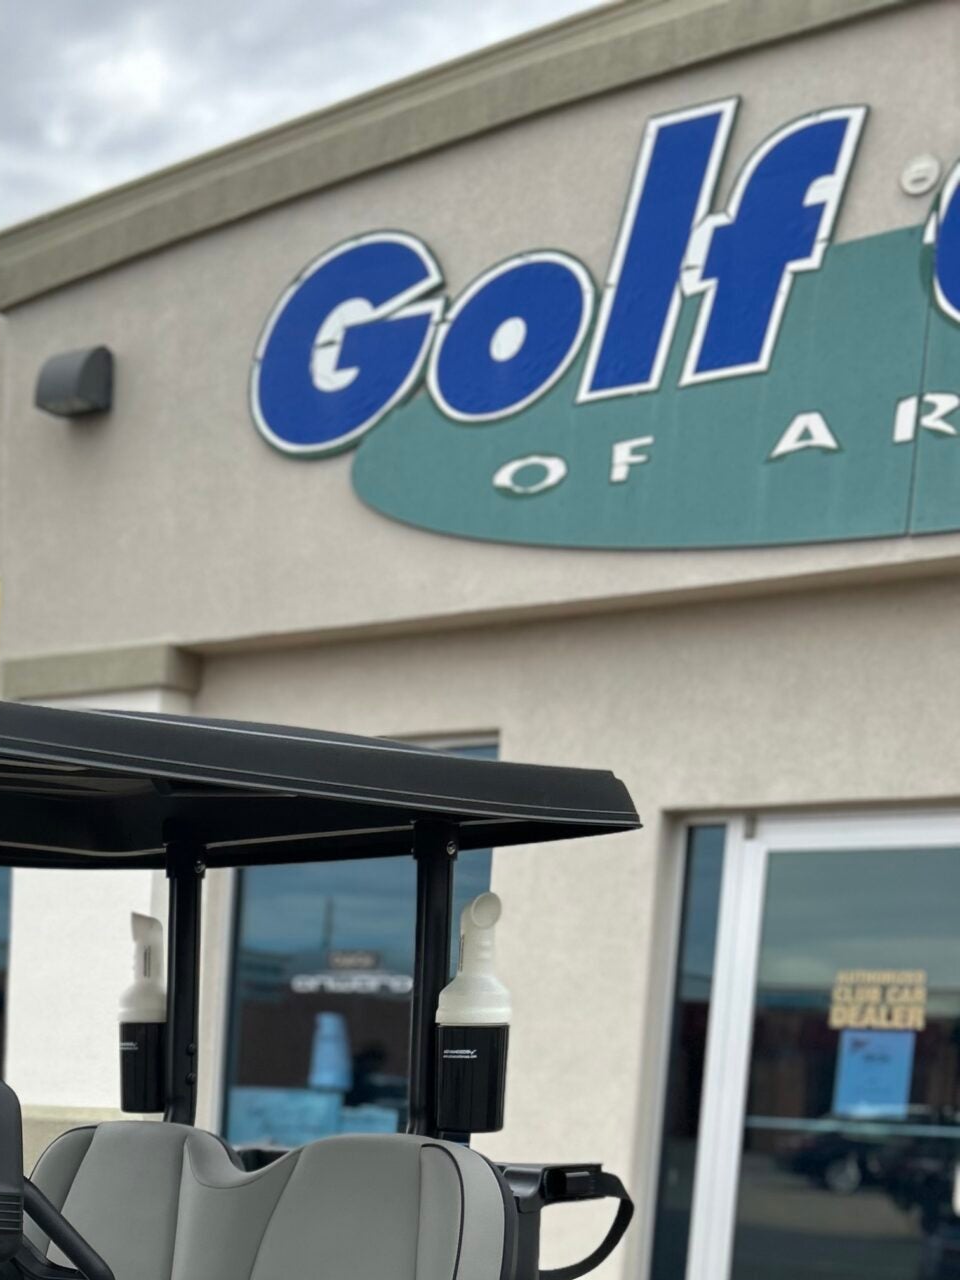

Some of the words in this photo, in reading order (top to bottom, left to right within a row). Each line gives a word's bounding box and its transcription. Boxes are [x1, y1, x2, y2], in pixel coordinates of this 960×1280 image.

[249, 95, 869, 457] Golf
[492, 436, 654, 494] OF
[828, 1004, 926, 1031] DEALER
